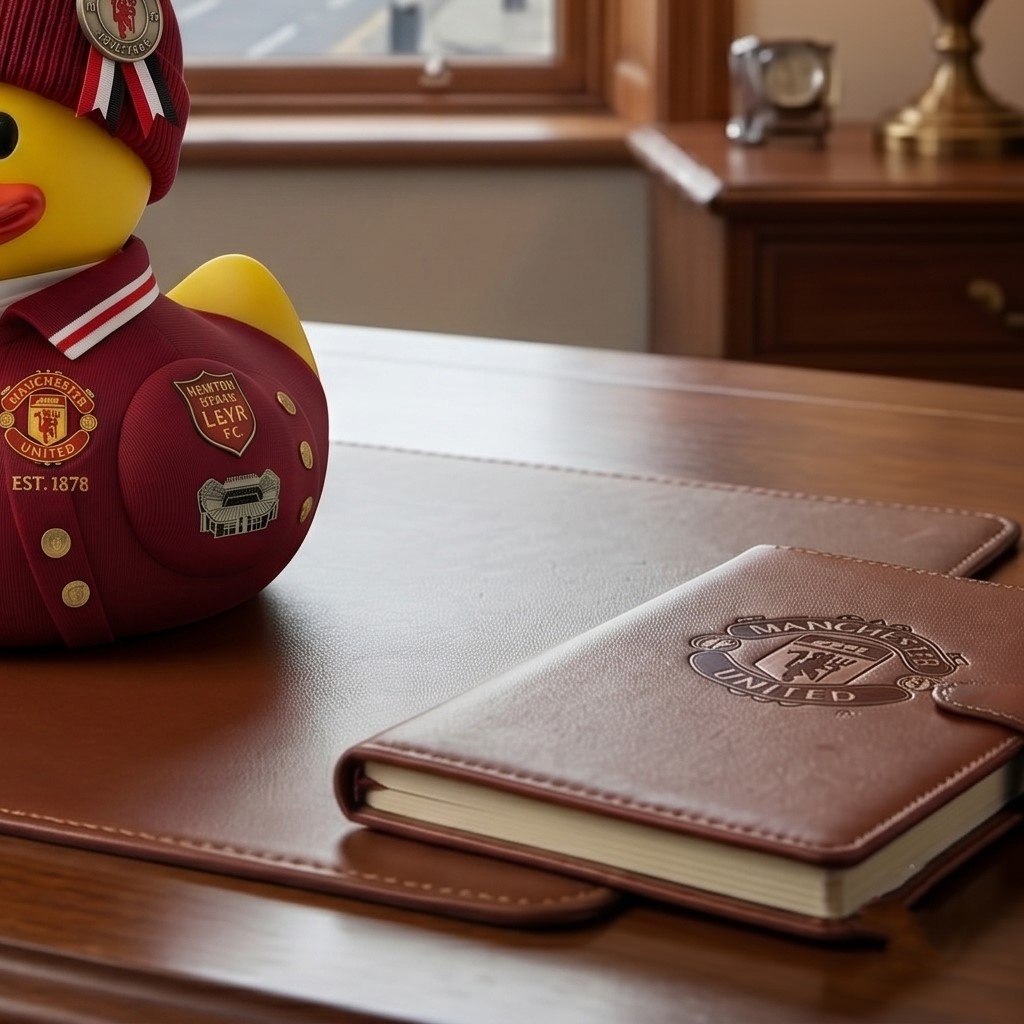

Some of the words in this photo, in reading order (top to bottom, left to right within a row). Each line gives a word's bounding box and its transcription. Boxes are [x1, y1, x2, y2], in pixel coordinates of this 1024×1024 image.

[201, 405, 248, 428] LEYR
[20, 442, 75, 458] UNITED
[12, 476, 48, 491] EST.
[51, 476, 89, 492] 1878
[713, 668, 856, 703] UNITED
